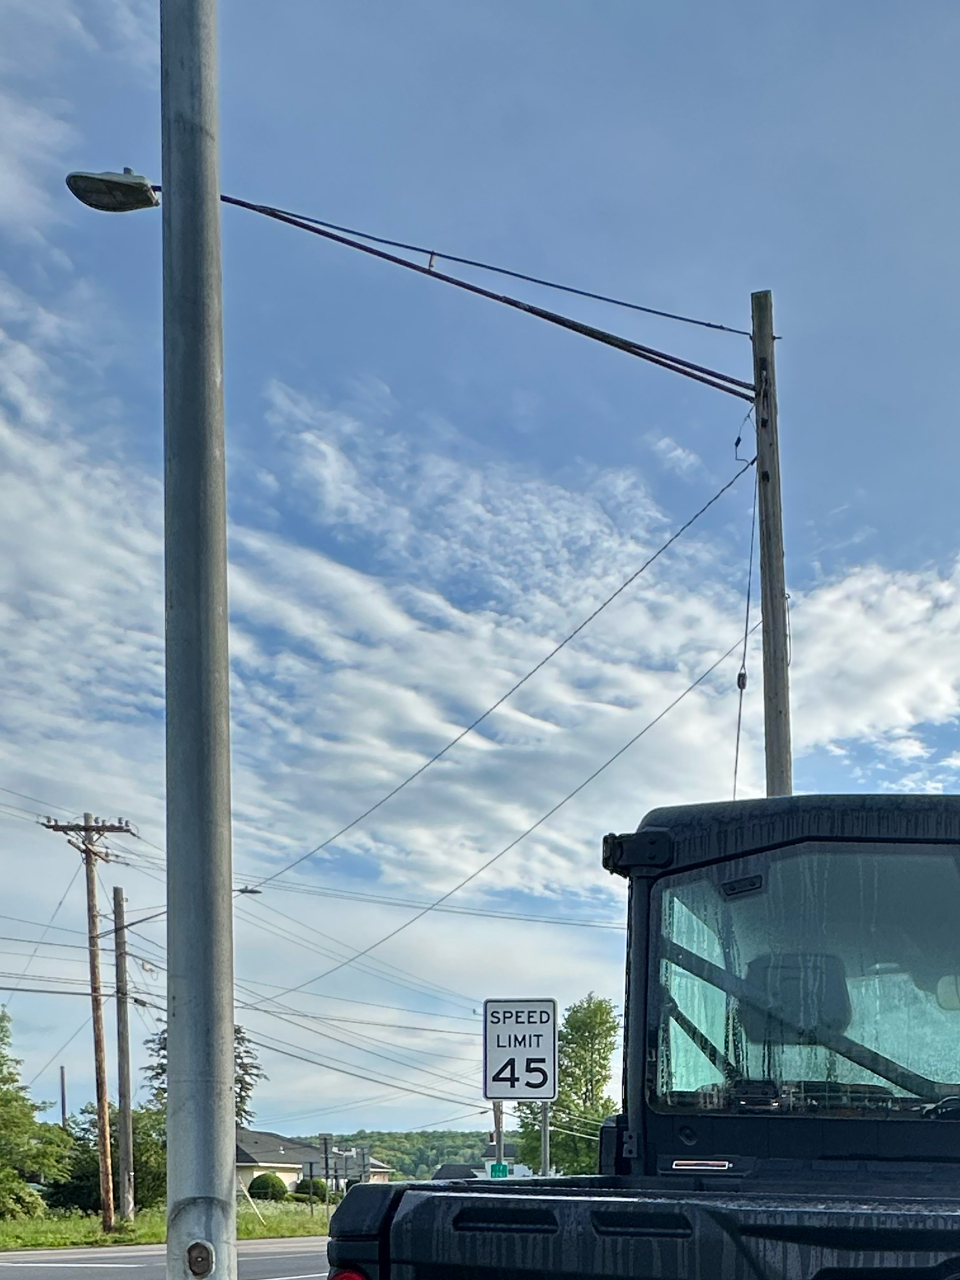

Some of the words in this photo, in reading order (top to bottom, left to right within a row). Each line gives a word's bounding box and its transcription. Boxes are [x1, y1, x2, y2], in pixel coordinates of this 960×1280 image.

[490, 1010, 550, 1024] SPEED
[496, 1034, 544, 1048] LIMIT
[492, 1057, 549, 1089] 45
